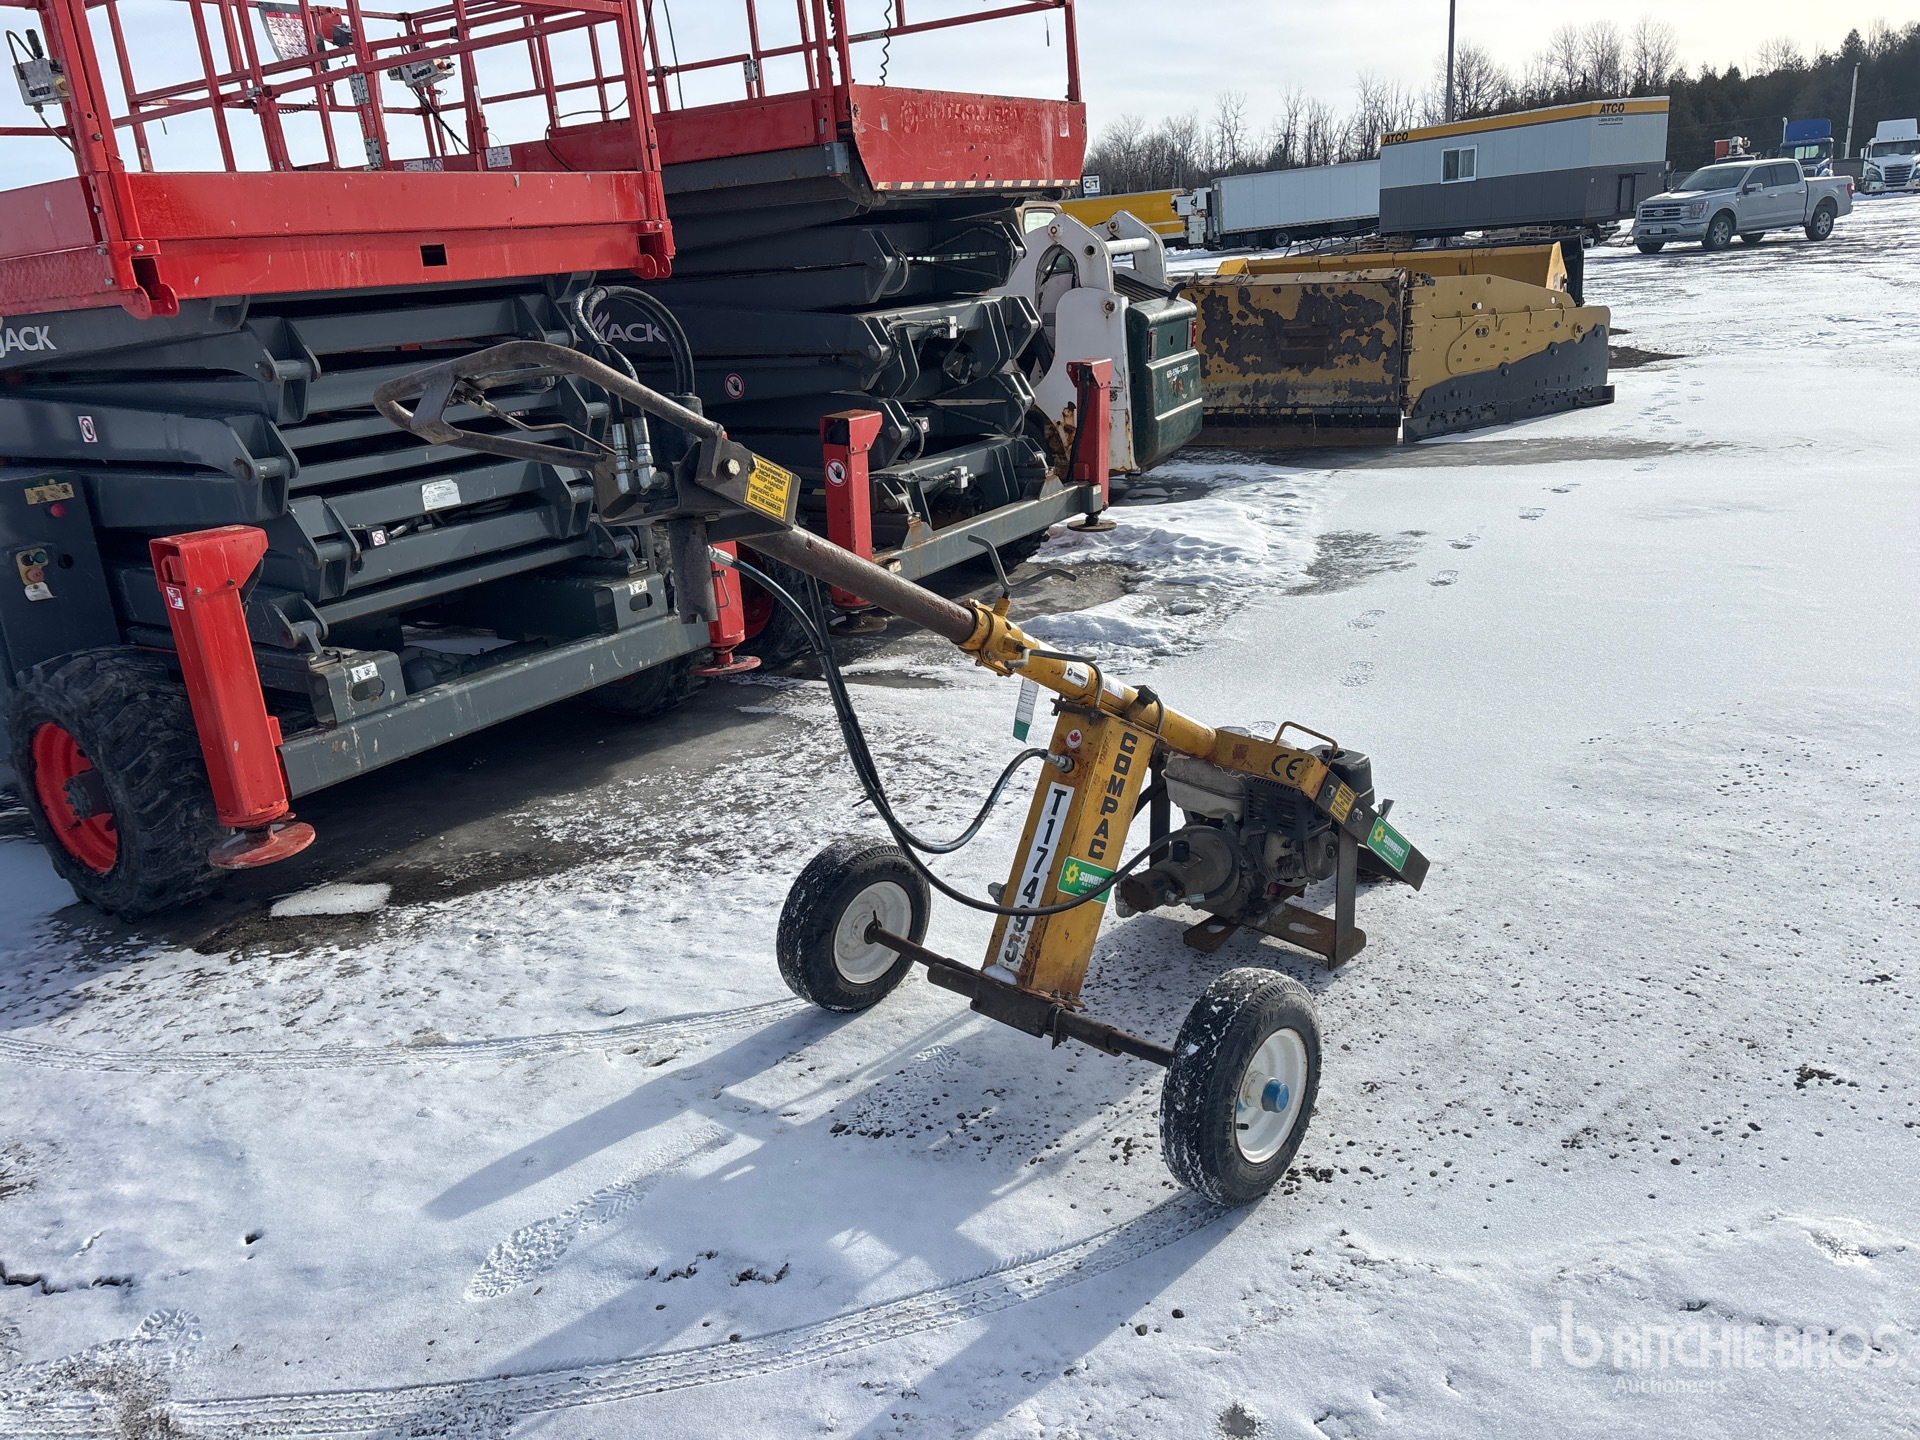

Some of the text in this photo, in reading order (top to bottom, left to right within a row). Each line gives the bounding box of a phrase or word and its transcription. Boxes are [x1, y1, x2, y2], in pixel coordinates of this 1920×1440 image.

[1600, 102, 1625, 114] ATCO
[1384, 131, 1409, 144] ATCO
[1271, 753, 1304, 780] CE
[1088, 731, 1138, 860] COMPAC
[1079, 871, 1106, 886] SUNBE
